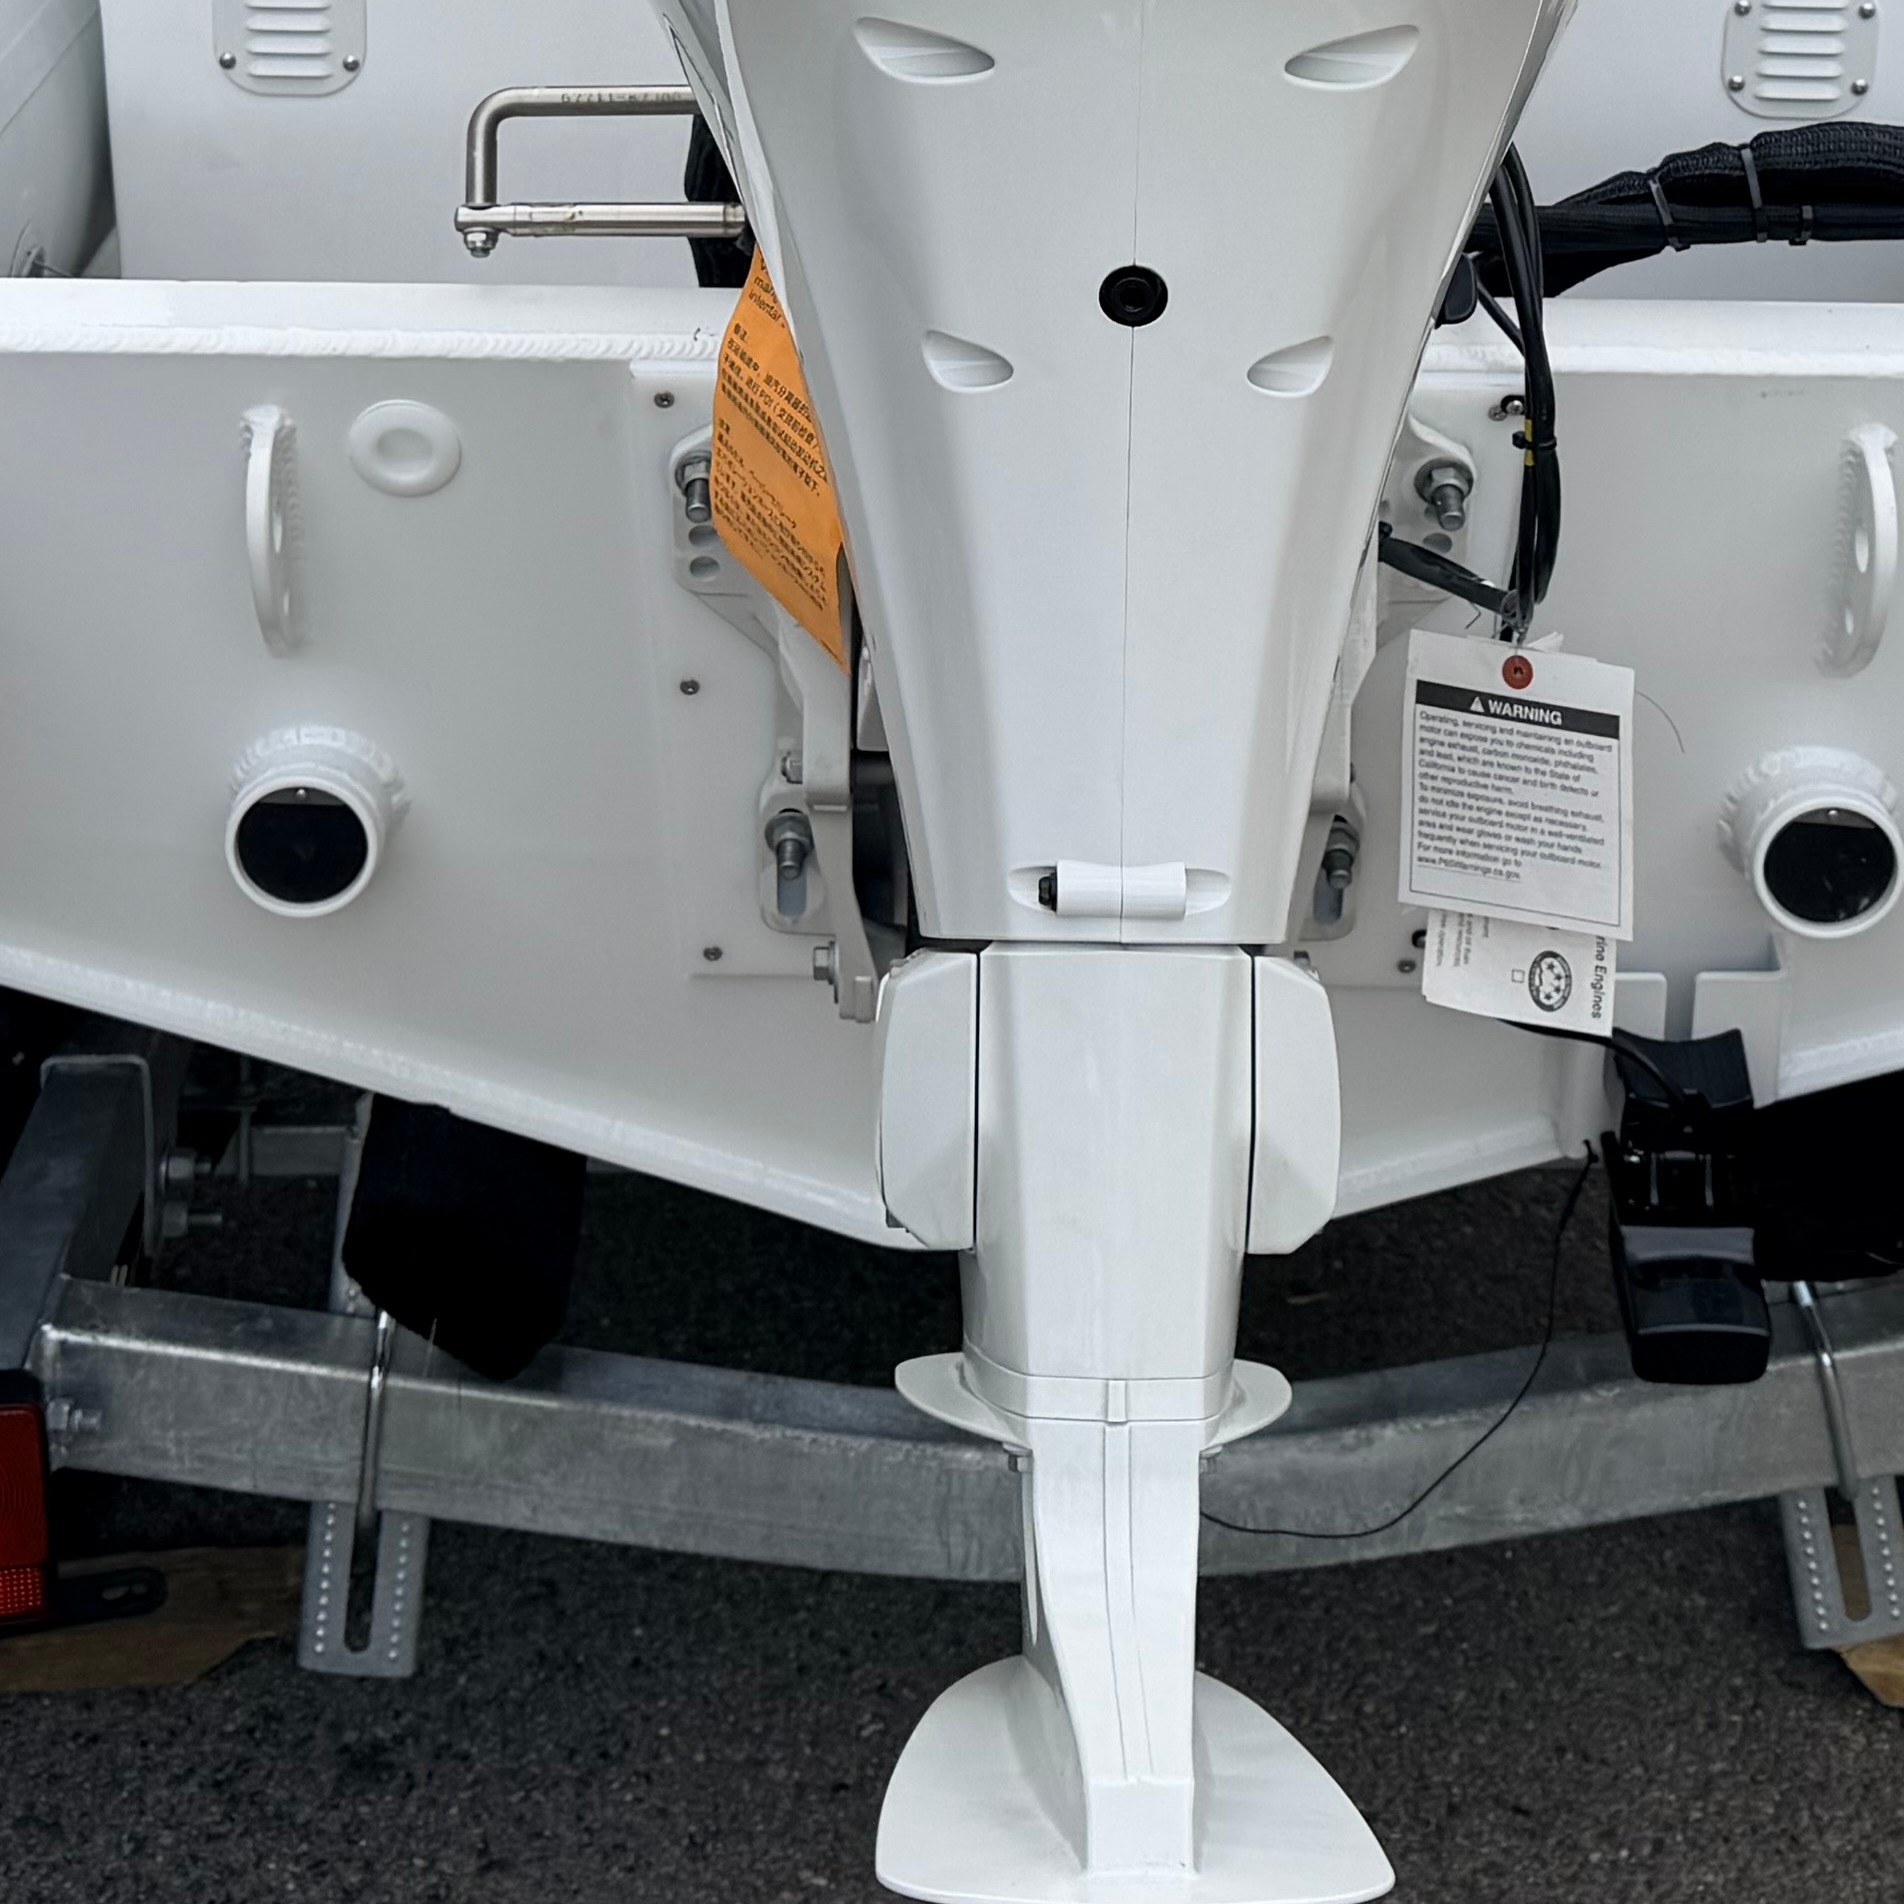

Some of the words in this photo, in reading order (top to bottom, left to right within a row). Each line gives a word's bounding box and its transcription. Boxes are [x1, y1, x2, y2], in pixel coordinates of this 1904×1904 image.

[1488, 698, 1563, 727] WARNING
[1595, 935, 1606, 962] rine
[1591, 965, 1607, 1019] Engines
